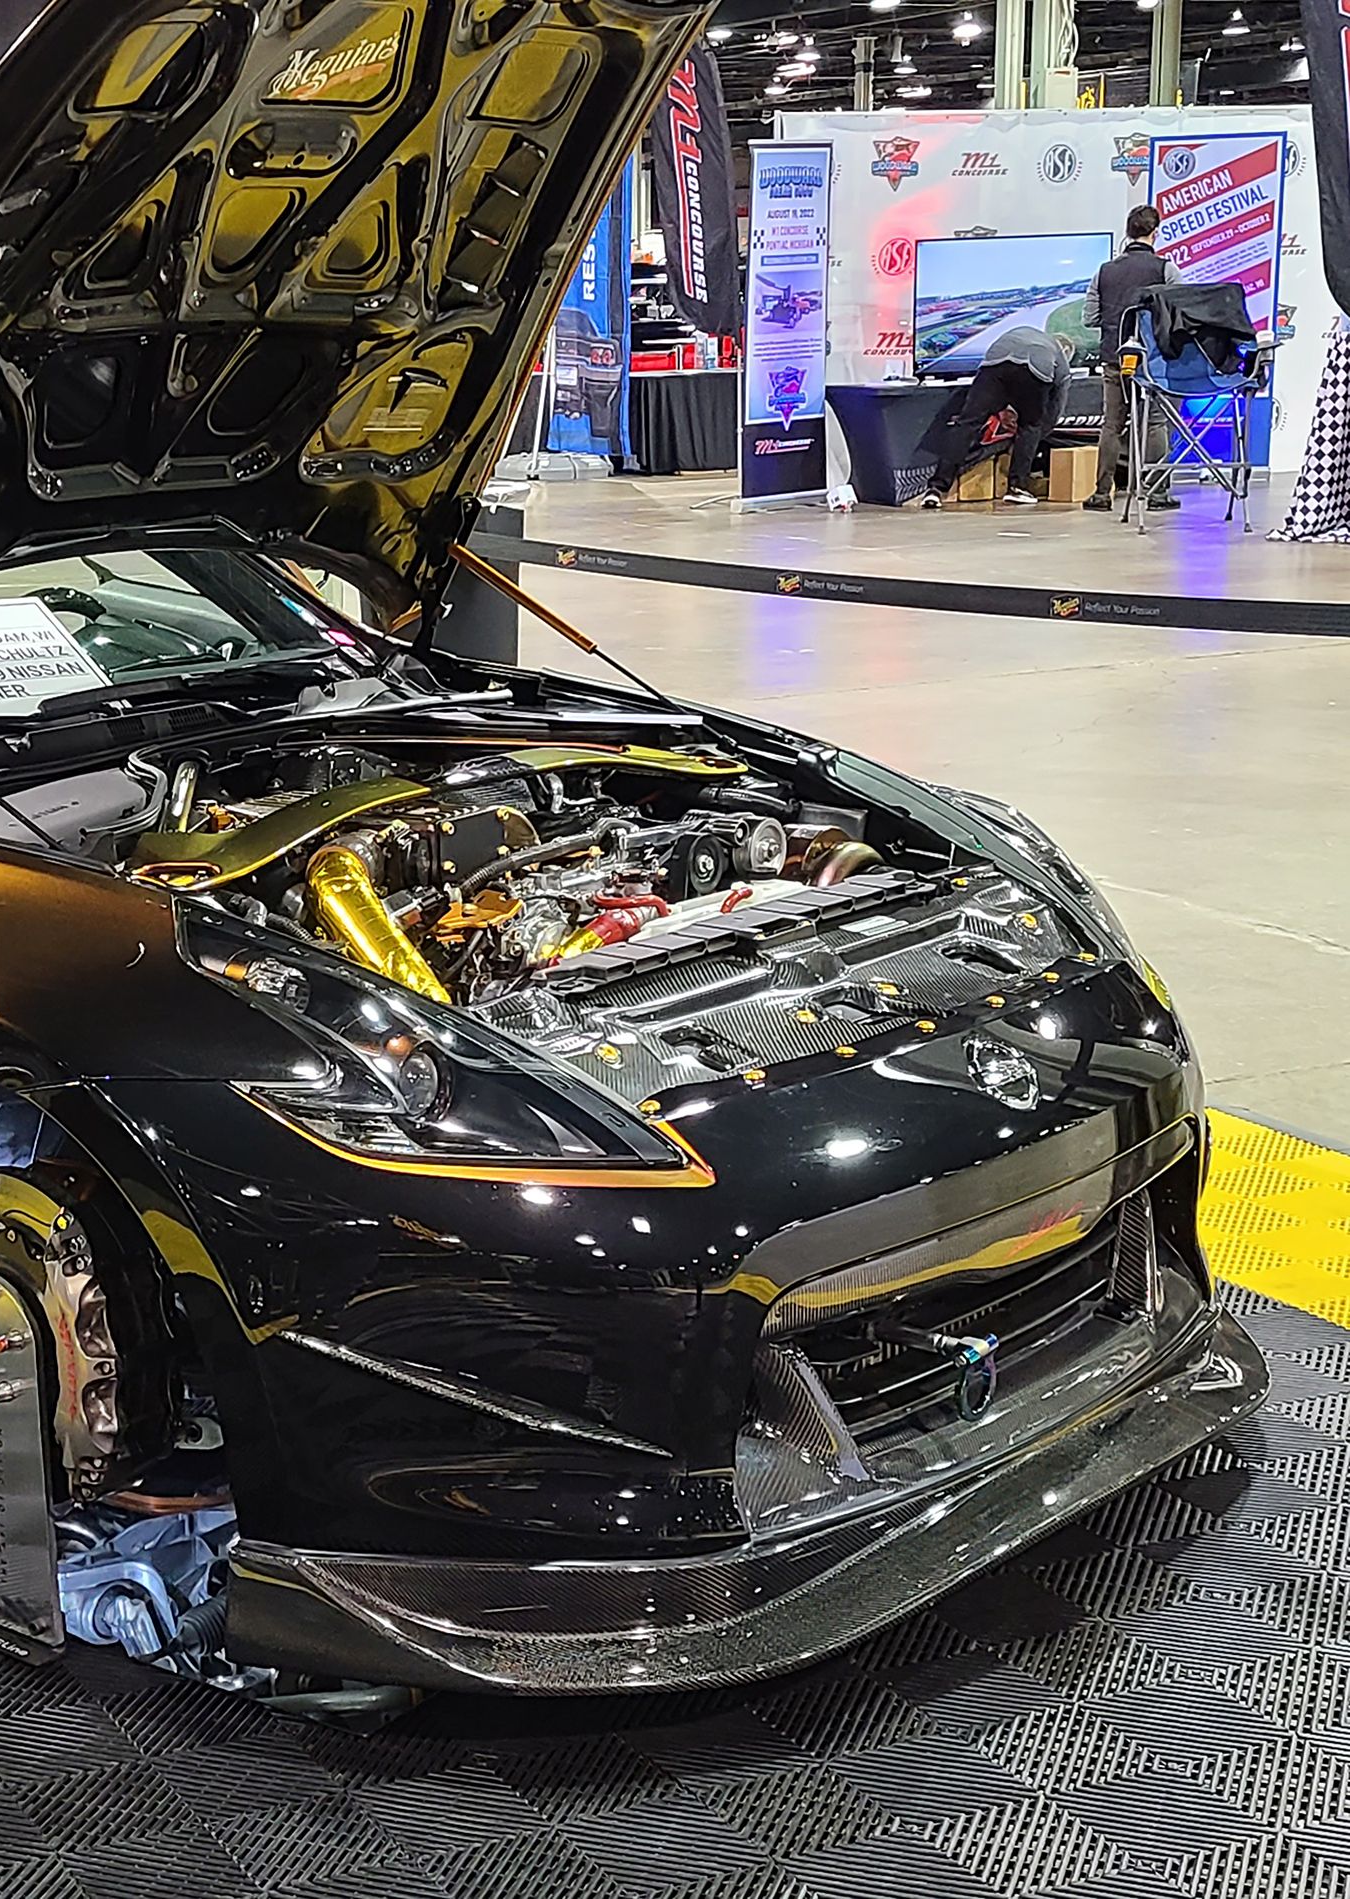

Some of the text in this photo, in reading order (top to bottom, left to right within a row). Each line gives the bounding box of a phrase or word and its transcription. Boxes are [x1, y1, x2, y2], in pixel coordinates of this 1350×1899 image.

[267, 31, 400, 100] Meguiar's
[1161, 168, 1233, 215] AMERICAN
[1161, 184, 1268, 242] SPEED FESTIVAL
[685, 160, 708, 304] CONCOURSE
[582, 229, 596, 301] RES
[1112, 604, 1129, 614] Your
[34, 629, 56, 642] WI
[5, 661, 86, 681] NISSAN
